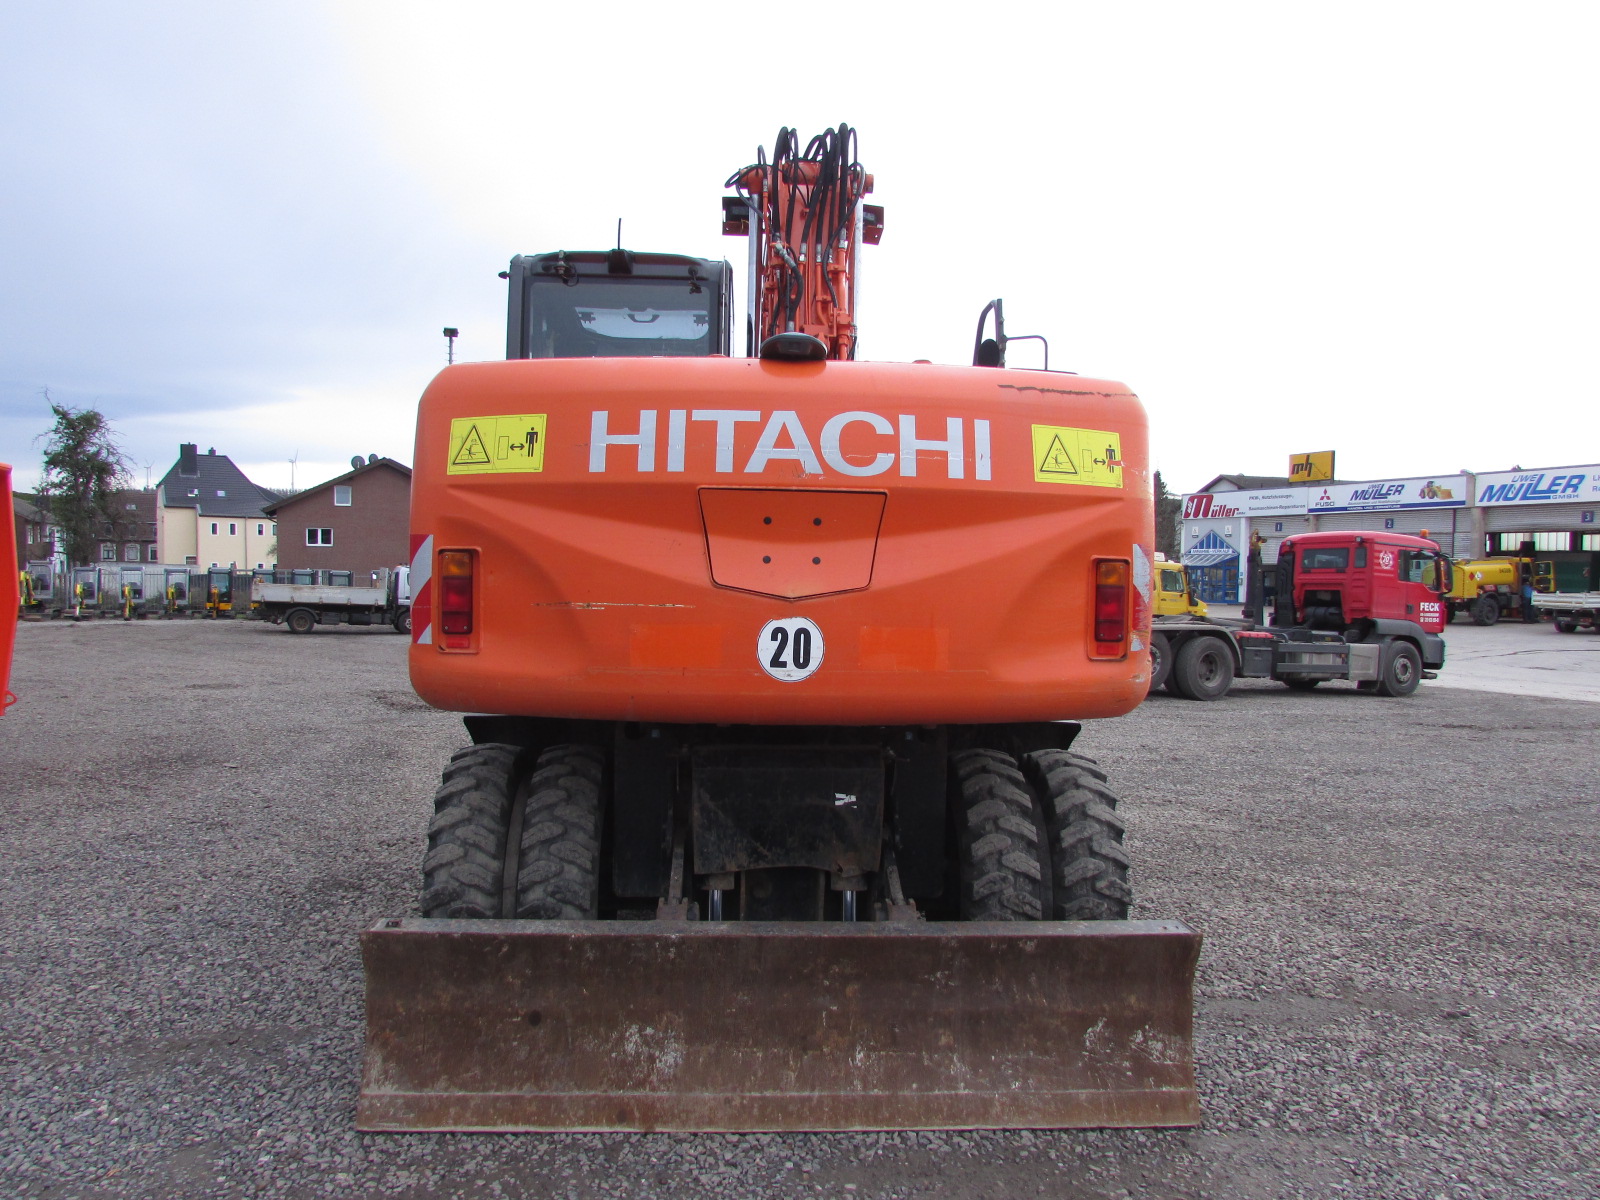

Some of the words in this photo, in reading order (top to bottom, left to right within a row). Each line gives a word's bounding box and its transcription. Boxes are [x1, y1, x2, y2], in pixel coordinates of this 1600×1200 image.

[588, 409, 992, 481] HITACHI
[1478, 473, 1586, 502] MÜLLER
[1511, 474, 1538, 483] UWE
[1349, 484, 1405, 501] MÜLLER
[1183, 494, 1240, 518] Müller
[1420, 602, 1440, 611] FECK
[769, 626, 812, 670] 20
